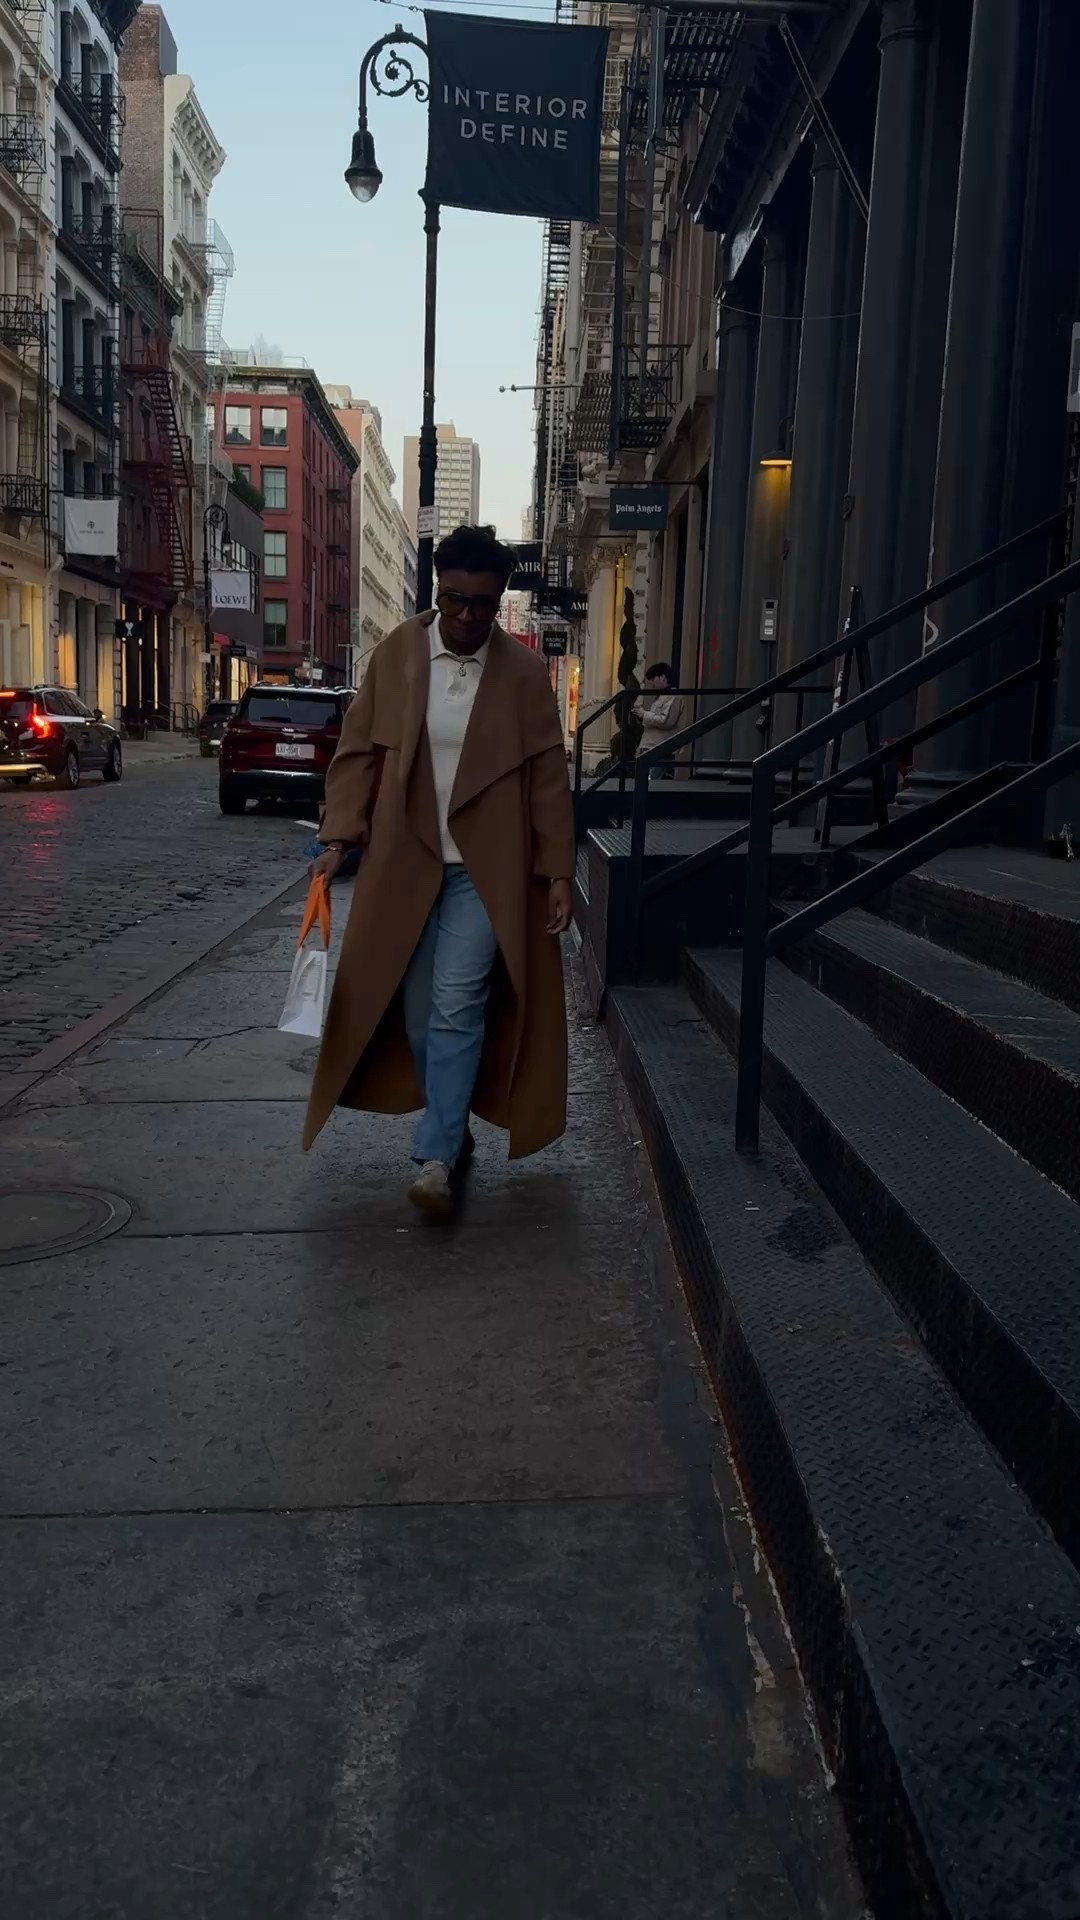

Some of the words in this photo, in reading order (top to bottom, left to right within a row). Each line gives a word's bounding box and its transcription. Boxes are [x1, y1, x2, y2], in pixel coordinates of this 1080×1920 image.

[443, 84, 588, 120] INTERIOR
[460, 117, 569, 150] DEFINE
[615, 503, 635, 514] Palm
[636, 503, 662, 515] Angels
[215, 595, 248, 605] LOEWE
